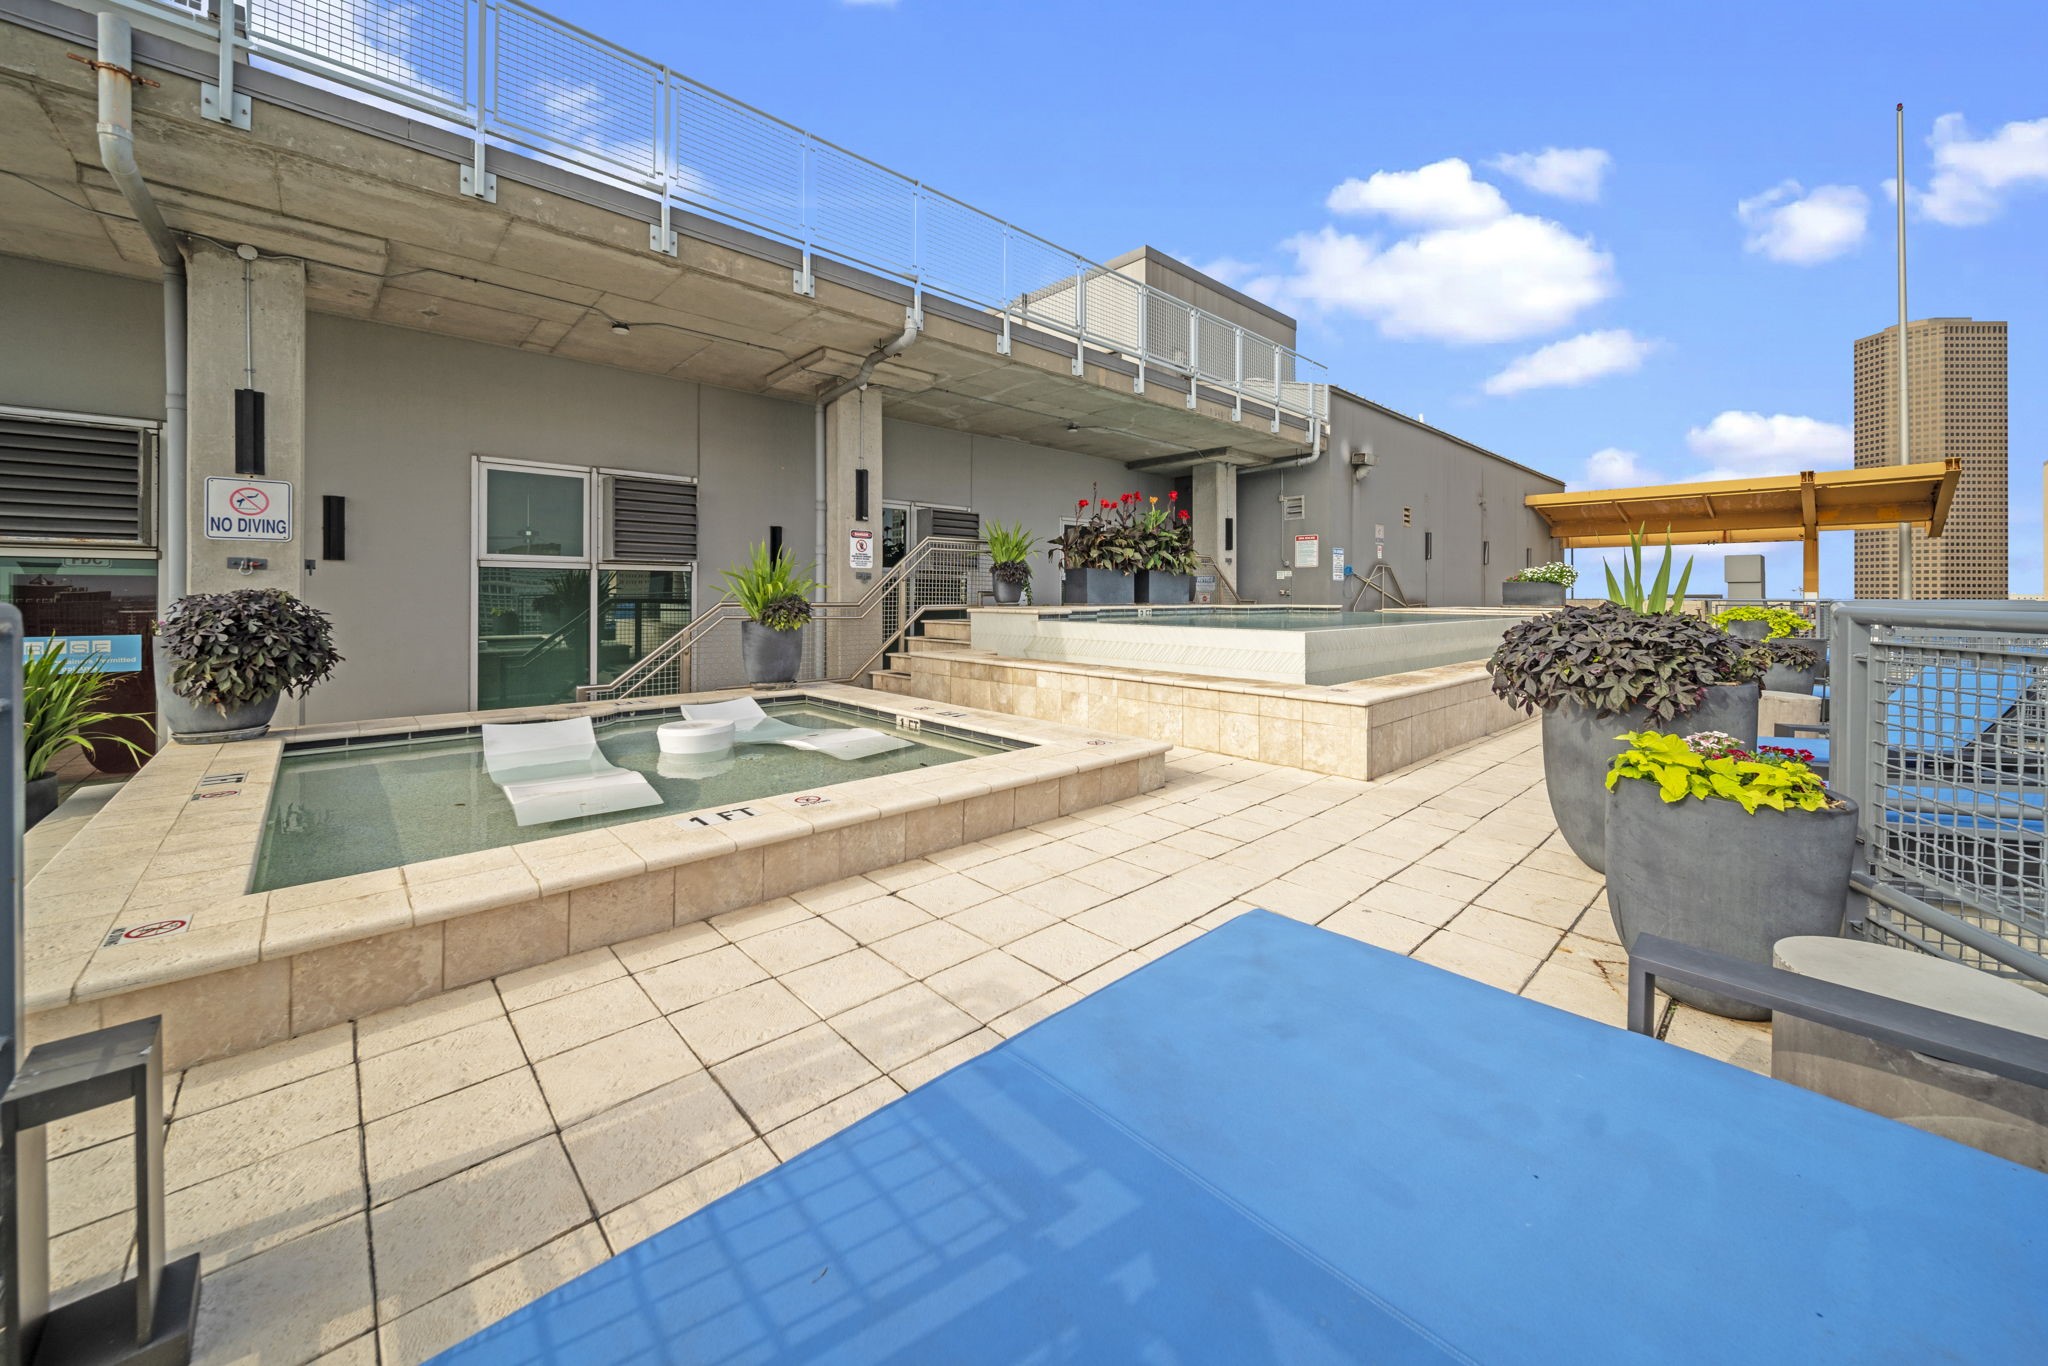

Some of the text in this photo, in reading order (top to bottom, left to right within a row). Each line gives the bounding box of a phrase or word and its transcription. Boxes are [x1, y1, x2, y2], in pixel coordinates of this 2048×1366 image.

[210, 516, 287, 534] NO DIVING
[689, 807, 755, 826] 1 FT
